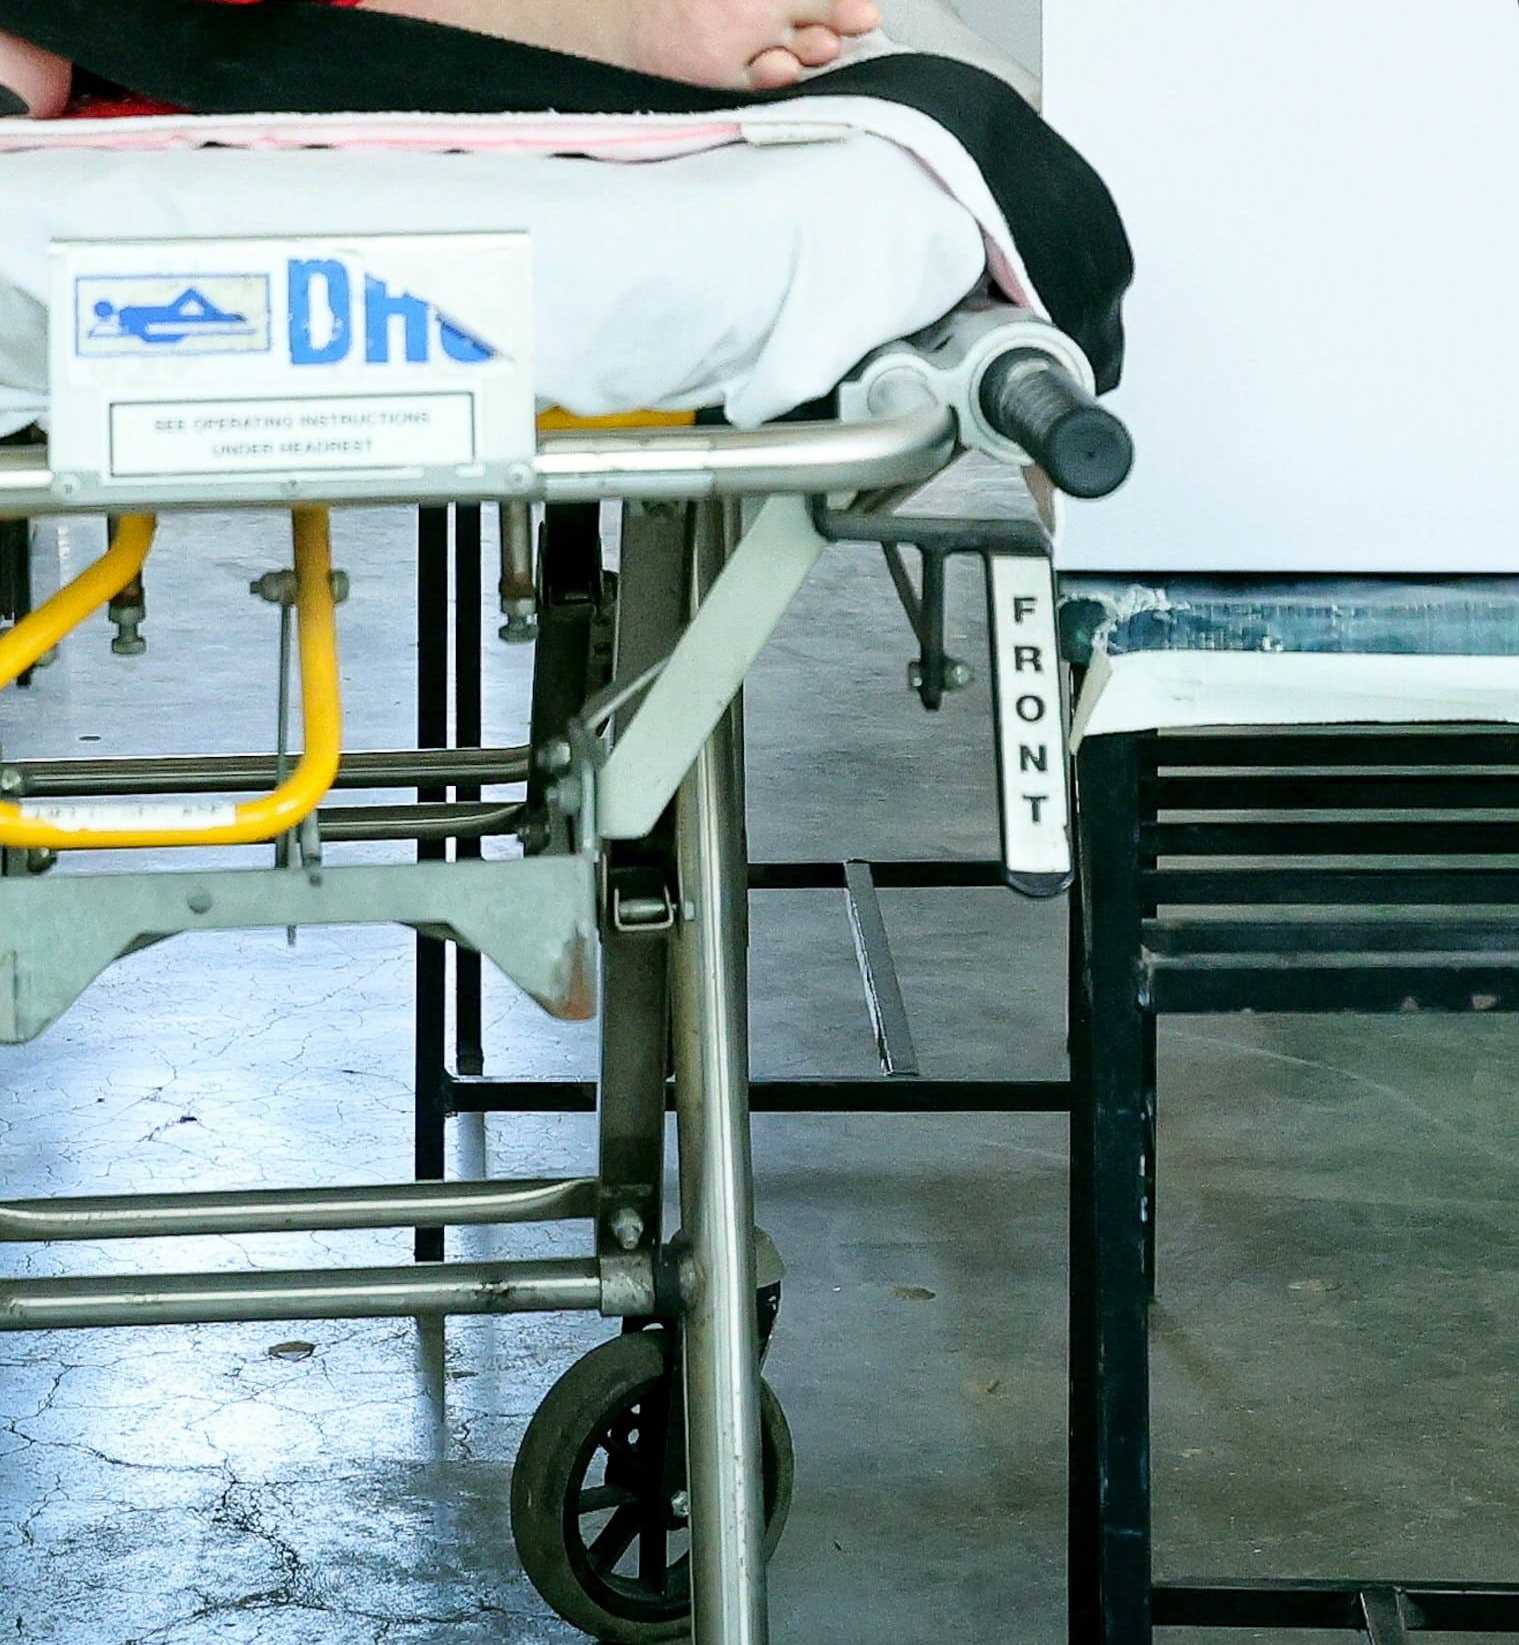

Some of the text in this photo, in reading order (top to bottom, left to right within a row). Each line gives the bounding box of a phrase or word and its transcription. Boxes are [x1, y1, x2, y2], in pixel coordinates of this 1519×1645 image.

[154, 410, 431, 432] SEE OPERATING INSTRUCTIONS
[212, 438, 374, 457] UNDER HEADREST
[1012, 596, 1050, 824] FRONT
